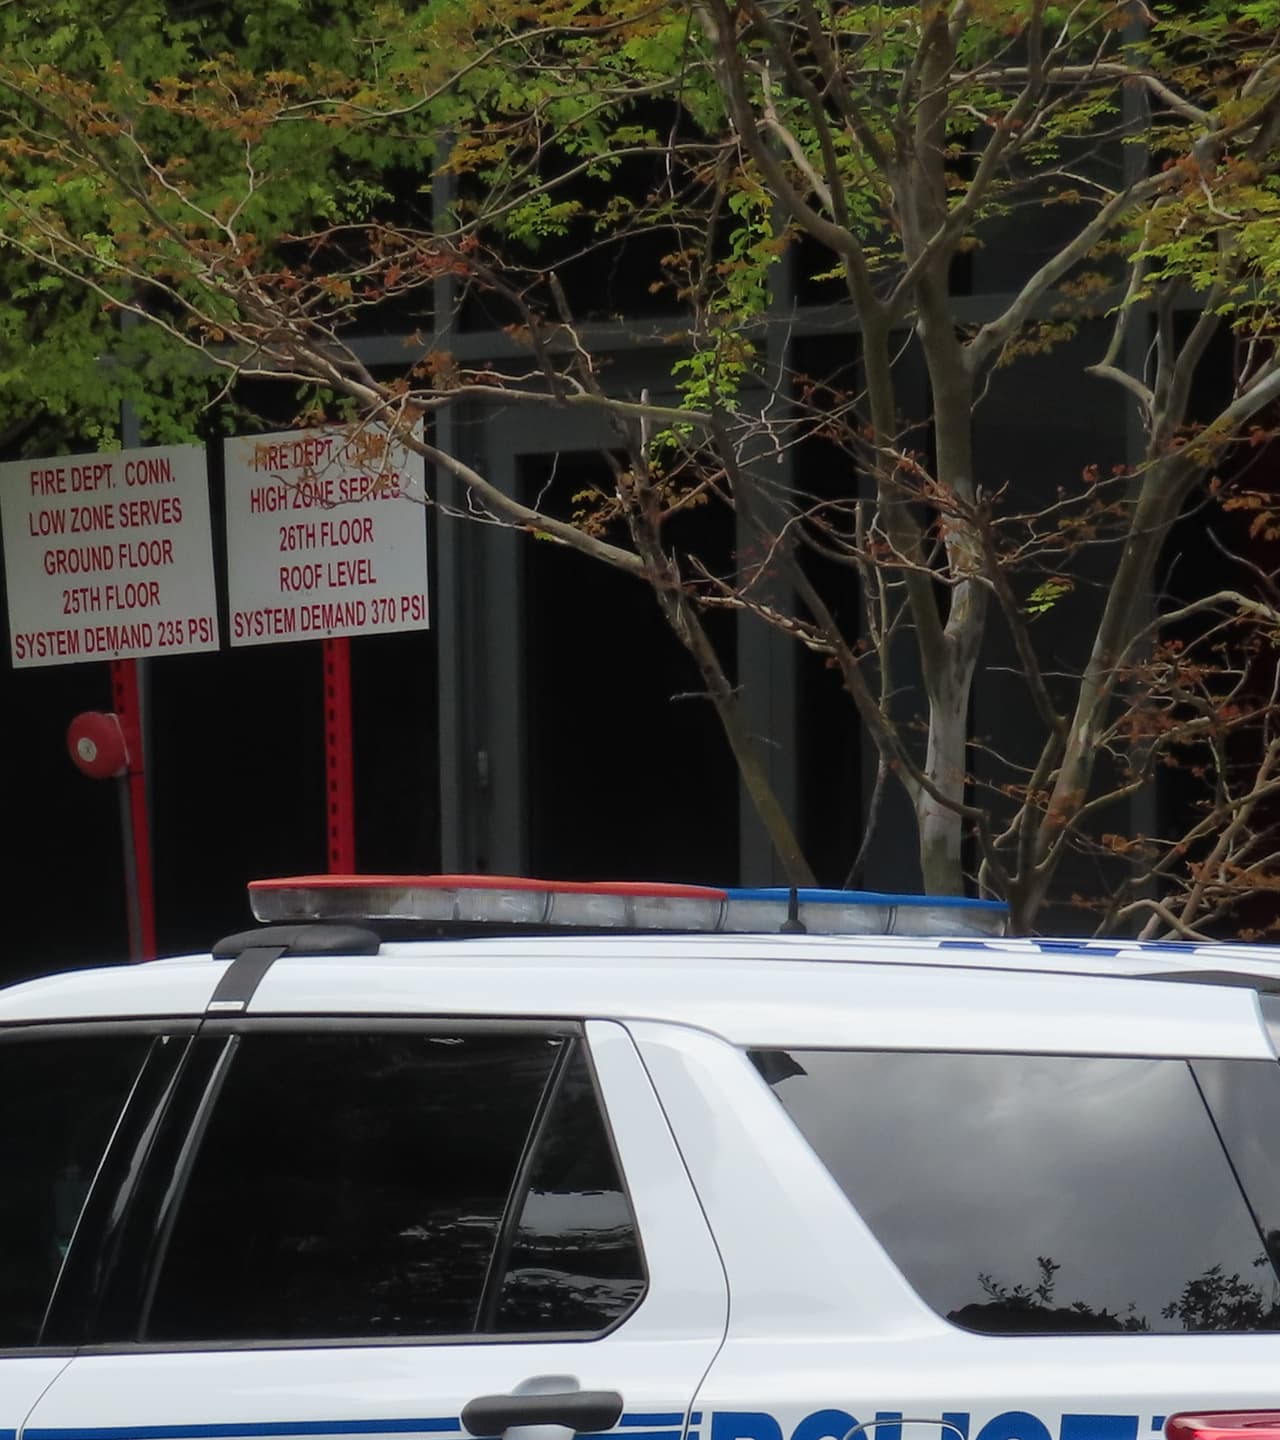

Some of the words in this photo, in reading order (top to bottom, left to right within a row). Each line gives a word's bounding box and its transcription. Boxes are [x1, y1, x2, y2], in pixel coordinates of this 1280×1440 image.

[30, 468, 67, 496] FIRE
[71, 464, 116, 492] DEPT.
[125, 457, 176, 486] CONN.
[29, 509, 66, 536] LOW
[70, 504, 115, 532] ZONE
[120, 497, 183, 528] SERVES
[250, 486, 288, 514] HIGH
[279, 524, 316, 551] 26TH
[321, 518, 374, 547] FLOOR
[44, 545, 114, 576] GROUND
[120, 539, 174, 570] FLOOR
[279, 564, 323, 592] ROOF
[328, 558, 377, 588] LEVEL
[63, 587, 101, 615] 25TH
[106, 581, 161, 611] FLOOR
[234, 607, 296, 638] SYSTEM
[300, 600, 367, 631] DEMAND
[371, 597, 396, 625] 370
[401, 594, 425, 622] PSI
[15, 629, 80, 660] SYSTEM
[84, 623, 153, 653] DEMAND
[157, 619, 184, 647] 235
[188, 616, 214, 644] PSI
